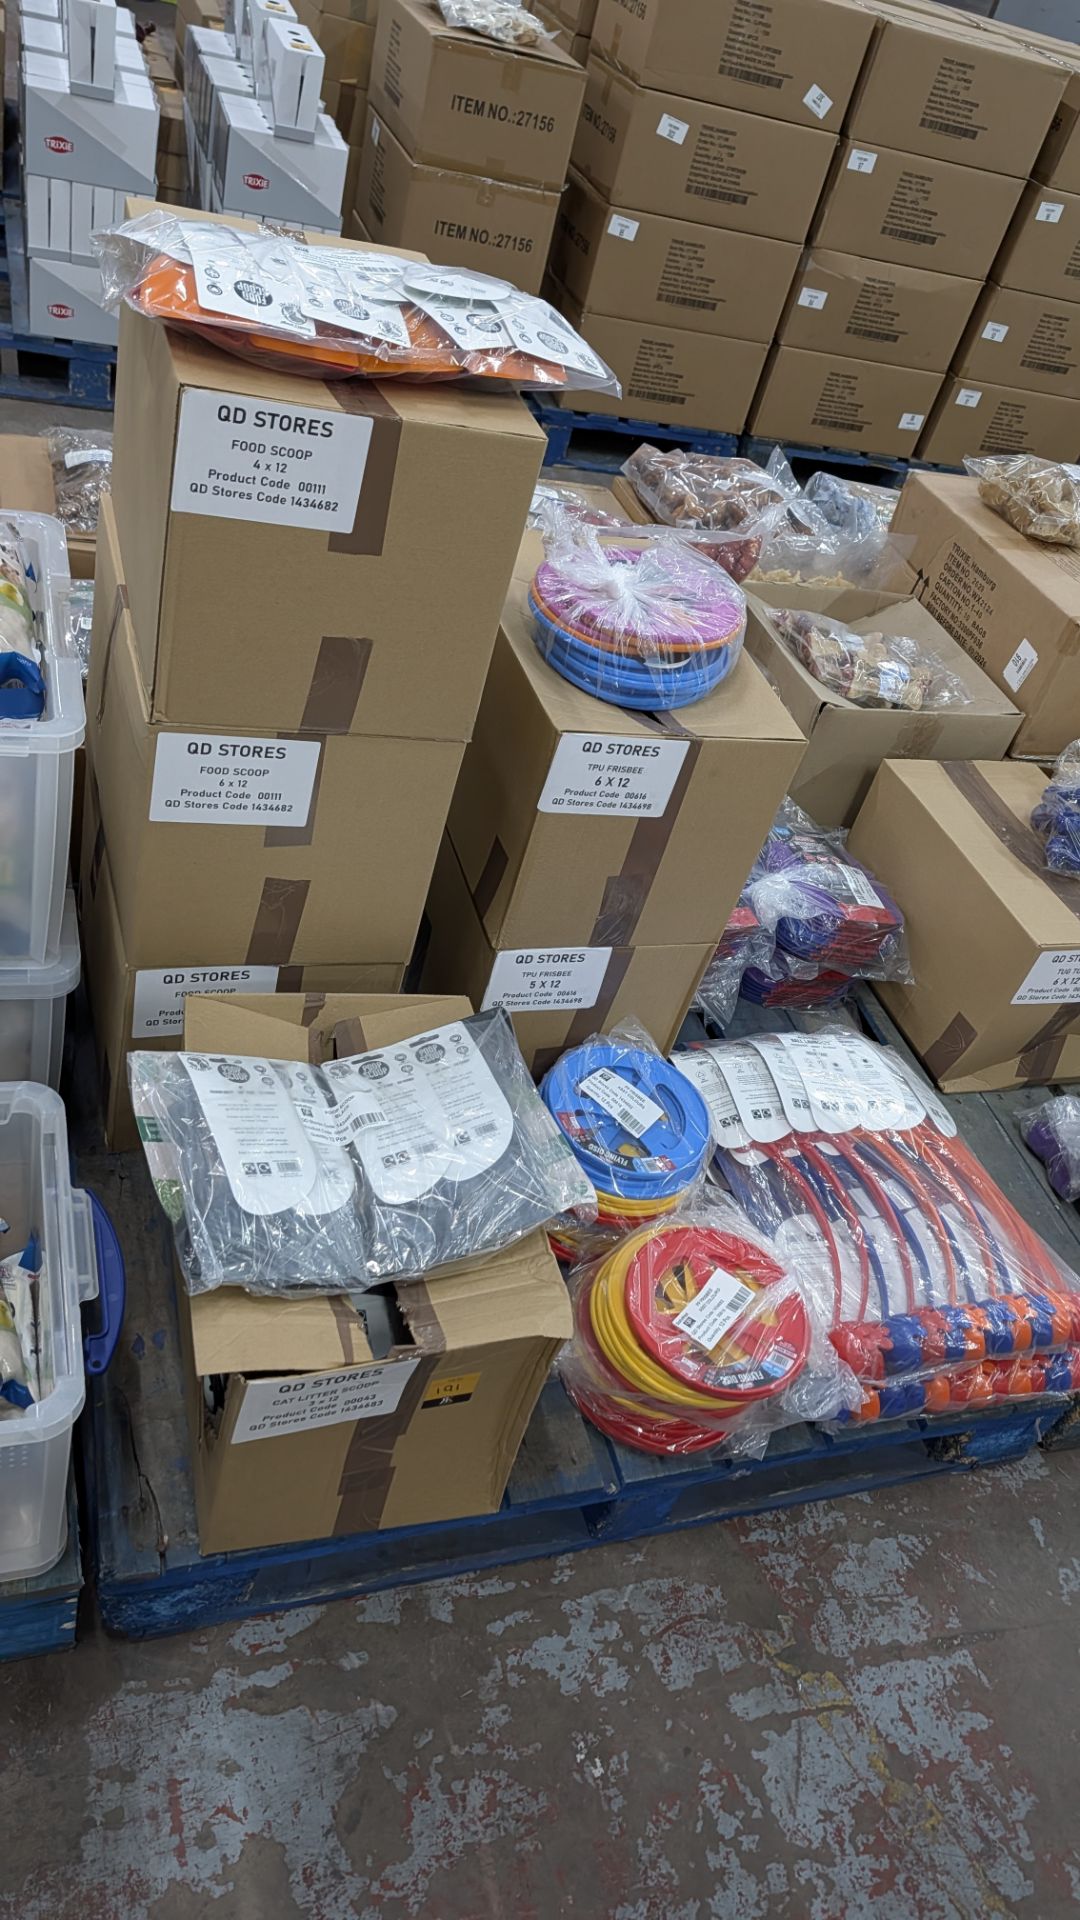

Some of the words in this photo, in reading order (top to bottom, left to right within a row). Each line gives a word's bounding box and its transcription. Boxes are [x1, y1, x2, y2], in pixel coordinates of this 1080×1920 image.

[451, 94, 486, 117] ITEM
[487, 103, 555, 133] NO.:27156
[434, 220, 467, 240] ITEM
[469, 229, 533, 253] NO.:27156
[217, 405, 247, 424] QD
[253, 411, 334, 438] STORES
[231, 439, 266, 454] FOOD
[270, 446, 313, 461] SCOOP
[253, 460, 260, 470] 4
[265, 464, 272, 472] x
[276, 462, 288, 473] 12
[207, 469, 256, 485] Product
[261, 476, 291, 490] Code
[298, 481, 327, 495] 00111
[190, 482, 208, 494] QD
[212, 486, 253, 501] Stores
[257, 492, 287, 505] Code
[290, 496, 339, 512] 1434682
[948, 553, 962, 568] ITEM
[943, 562, 964, 585] ORDER
[971, 562, 997, 591] Hamburg
[939, 572, 962, 598] CARTON
[187, 742, 212, 755] QD
[218, 744, 287, 759] STORES
[582, 741, 602, 753] QD
[606, 743, 661, 757] STORES
[199, 766, 229, 775] FOOD
[233, 768, 270, 777] SCOOP
[606, 764, 645, 774] FRISBEE
[219, 779, 225, 787] 6
[237, 780, 248, 788] 12
[595, 776, 602, 786] 6
[605, 777, 616, 787] X
[617, 778, 630, 788] 12
[180, 789, 221, 798] Product
[225, 791, 251, 799] Code
[258, 792, 282, 800] 00111
[564, 788, 597, 797] Product
[599, 790, 619, 799] Code
[165, 800, 180, 808] QD
[184, 800, 219, 809] Stores
[223, 802, 248, 810] Code
[251, 803, 293, 812] 1434682
[566, 799, 594, 807] Stores
[596, 801, 617, 809] Code
[516, 955, 533, 964] QD
[537, 954, 585, 964] STORES
[1052, 955, 1066, 963] QD
[163, 974, 185, 984] QD
[190, 970, 250, 982] STORES
[539, 970, 572, 978] FRISBEE
[530, 981, 536, 989] 5
[539, 981, 547, 989] X
[550, 980, 561, 988] 12
[278, 1382, 306, 1394] QD
[310, 1368, 385, 1389] STORES
[272, 1396, 296, 1406] CAT
[298, 1389, 338, 1402] LITTER
[328, 1395, 340, 1403] 12
[262, 1410, 307, 1421] Product
[310, 1404, 337, 1413] Code
[249, 1423, 266, 1431] QD
[270, 1416, 307, 1428] Stores
[309, 1410, 337, 1420] Code
